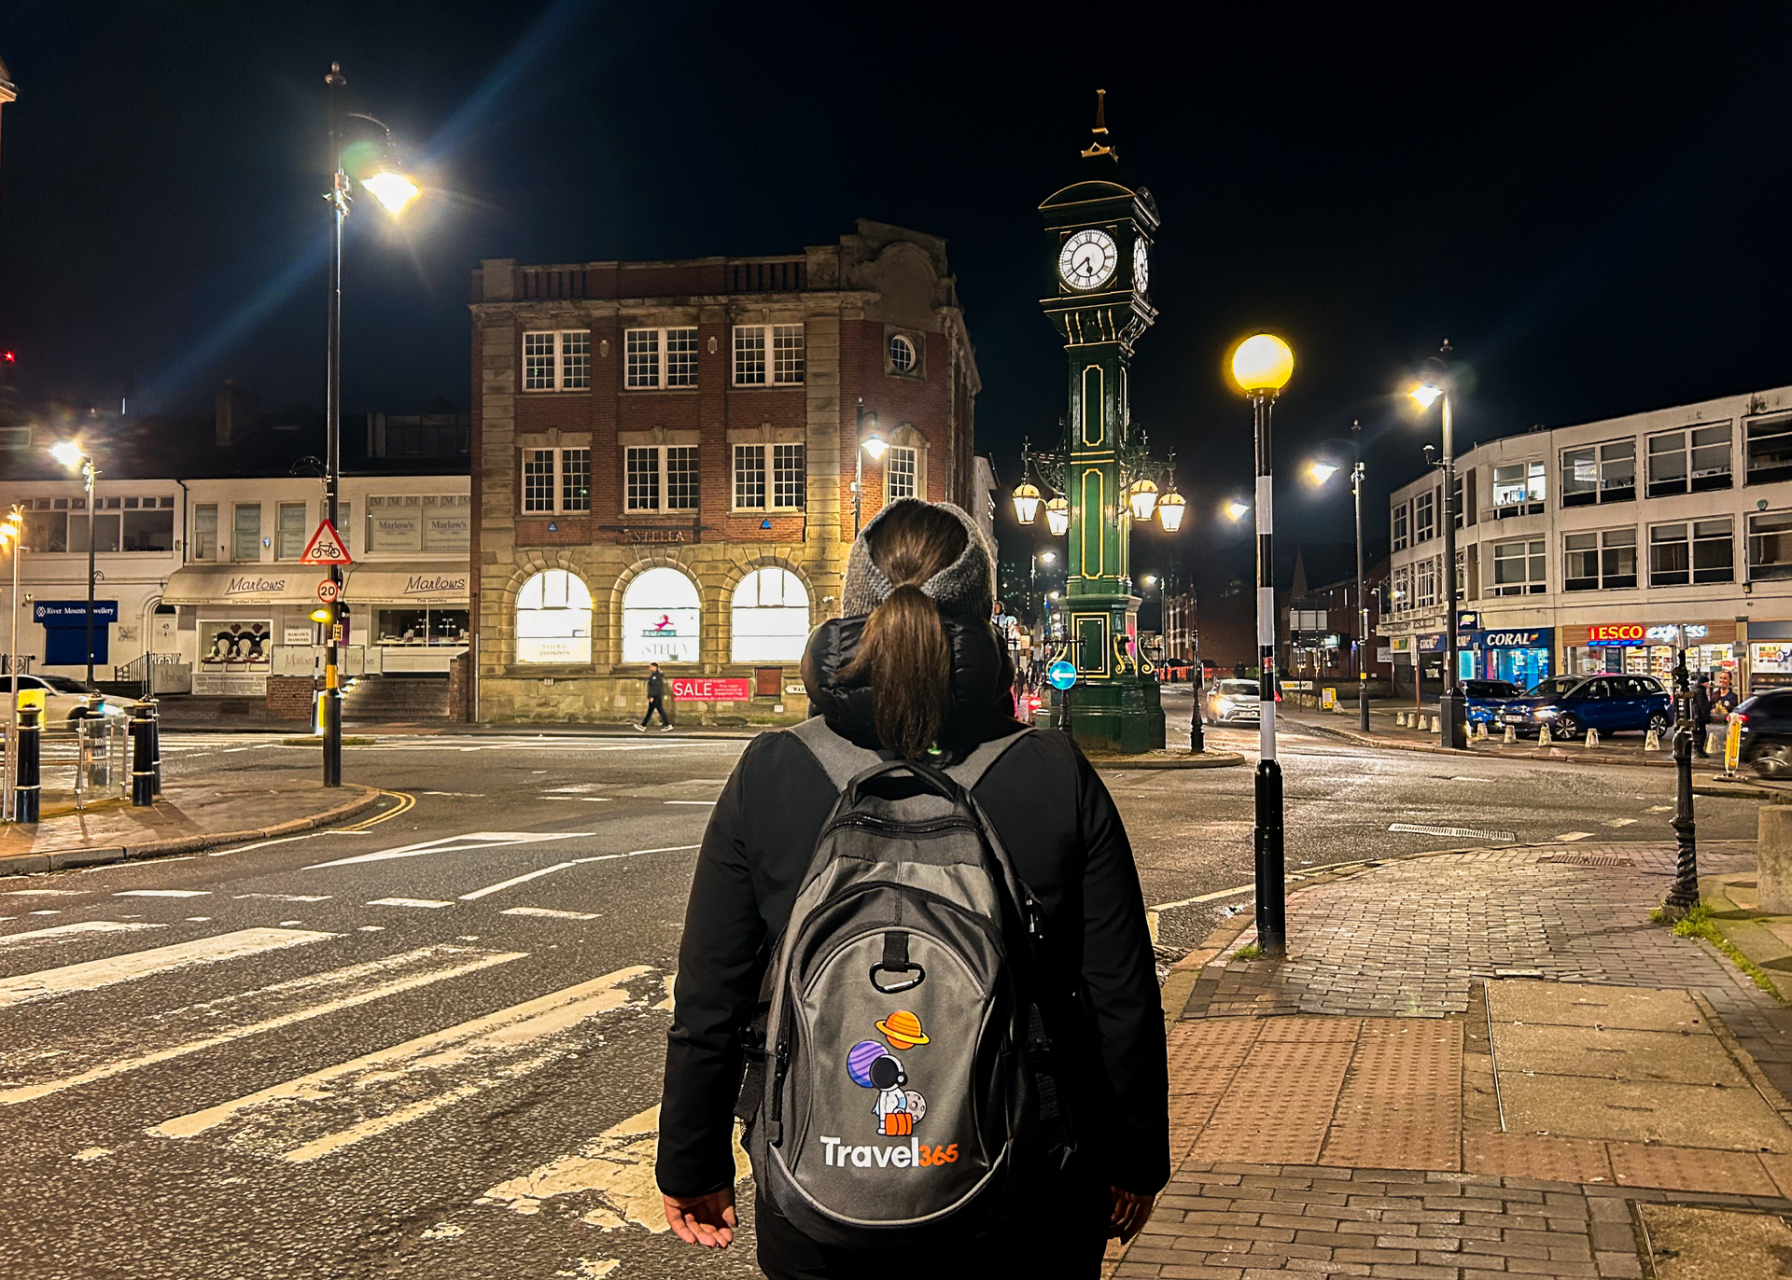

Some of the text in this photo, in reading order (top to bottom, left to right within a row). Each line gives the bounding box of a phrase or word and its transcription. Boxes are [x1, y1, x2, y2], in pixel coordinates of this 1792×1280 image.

[379, 520, 414, 530] Marlow's
[432, 520, 467, 528] Marlow's
[226, 576, 285, 593] Marlows
[320, 586, 336, 596] 20
[404, 576, 465, 592] Marlows
[92, 606, 114, 615] wellery
[1486, 632, 1530, 646] CORAL
[674, 682, 712, 696] SALE
[820, 1136, 959, 1168] Travel365
